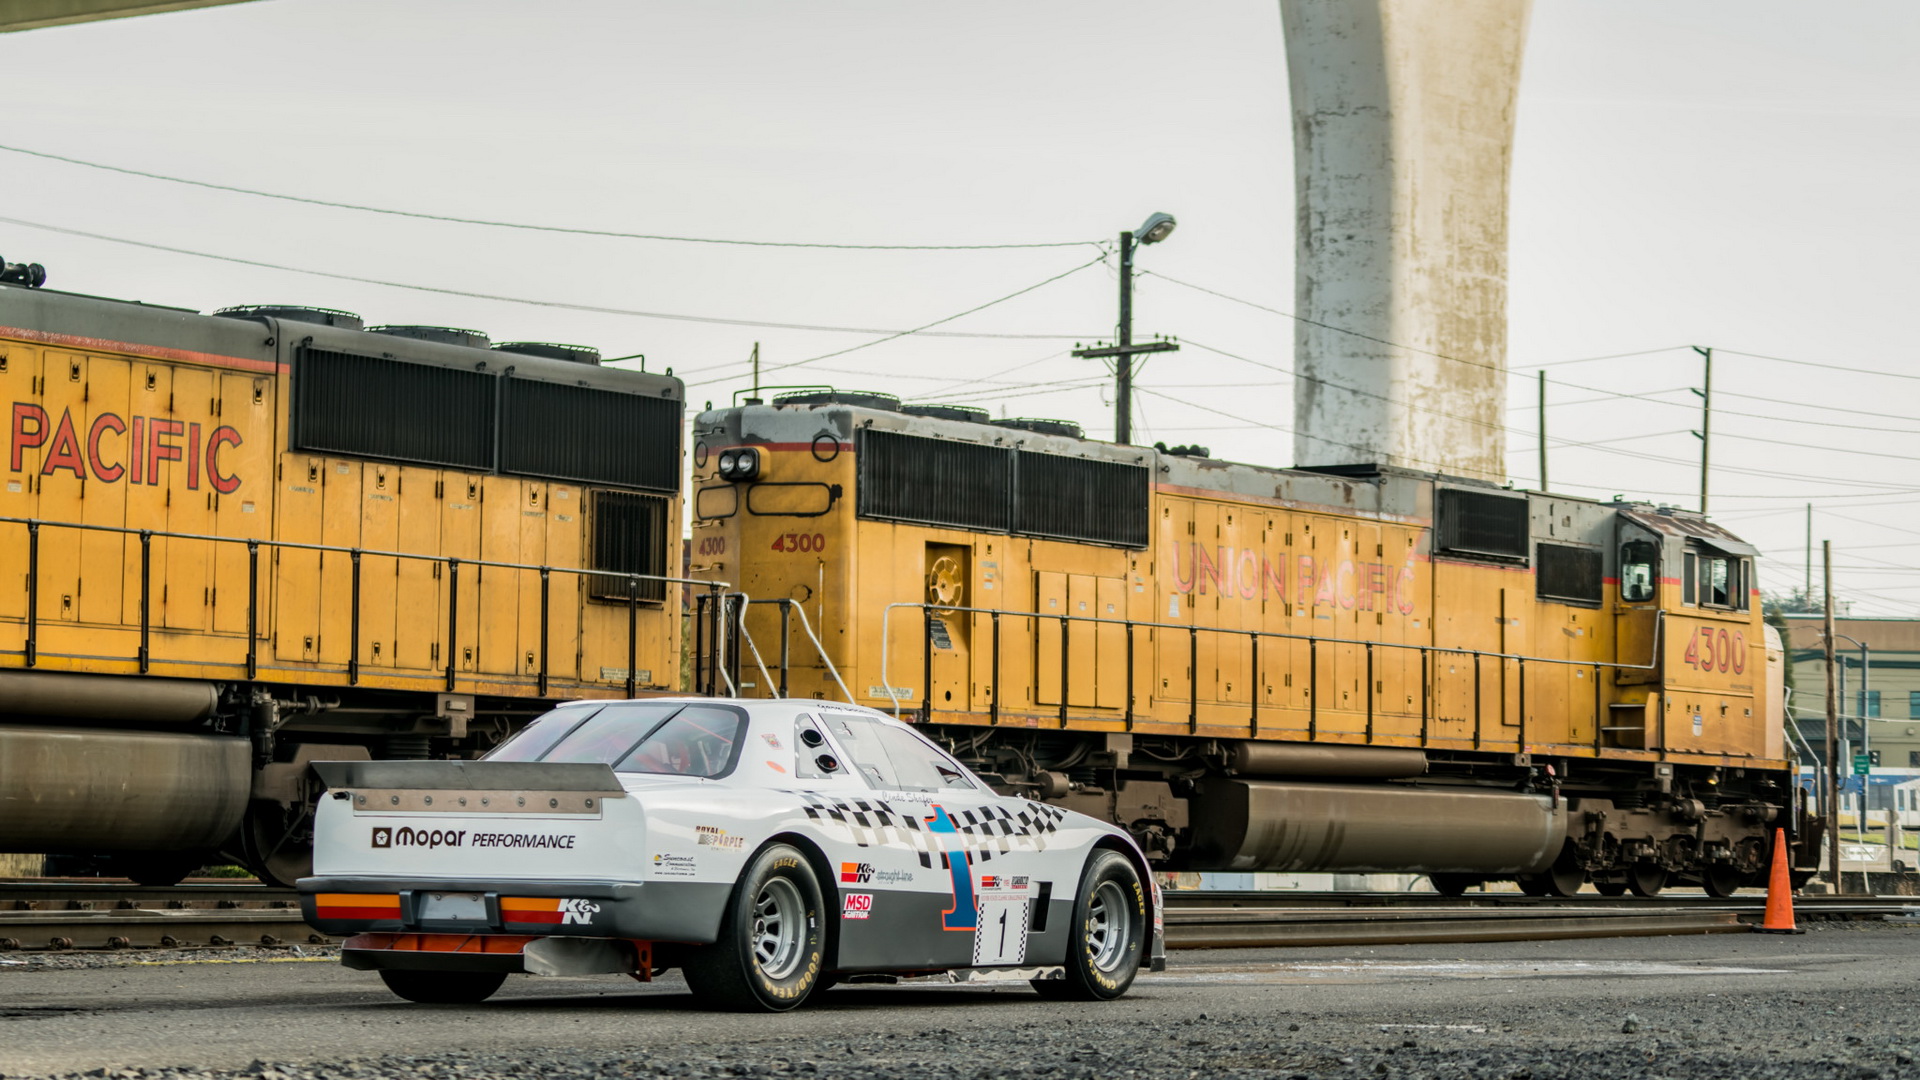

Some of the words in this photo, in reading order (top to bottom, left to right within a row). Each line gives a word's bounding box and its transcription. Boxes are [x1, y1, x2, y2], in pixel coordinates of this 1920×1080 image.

[10, 401, 243, 495] PACIFIC
[698, 536, 725, 556] 4300
[771, 533, 825, 553] 4300
[1173, 541, 1287, 605] UNION
[1297, 555, 1415, 616] PACIFIC
[1685, 626, 1746, 675] 4300
[695, 825, 719, 834] ROYAL
[471, 833, 576, 849] PERFORMANCE
[712, 834, 744, 848] PURPLE
[773, 857, 798, 870] EAGLE
[856, 863, 875, 883] K&N
[846, 895, 871, 911] MSD
[1132, 881, 1145, 916] EAGLE
[558, 898, 600, 925] K&N
[999, 908, 1008, 958] 1
